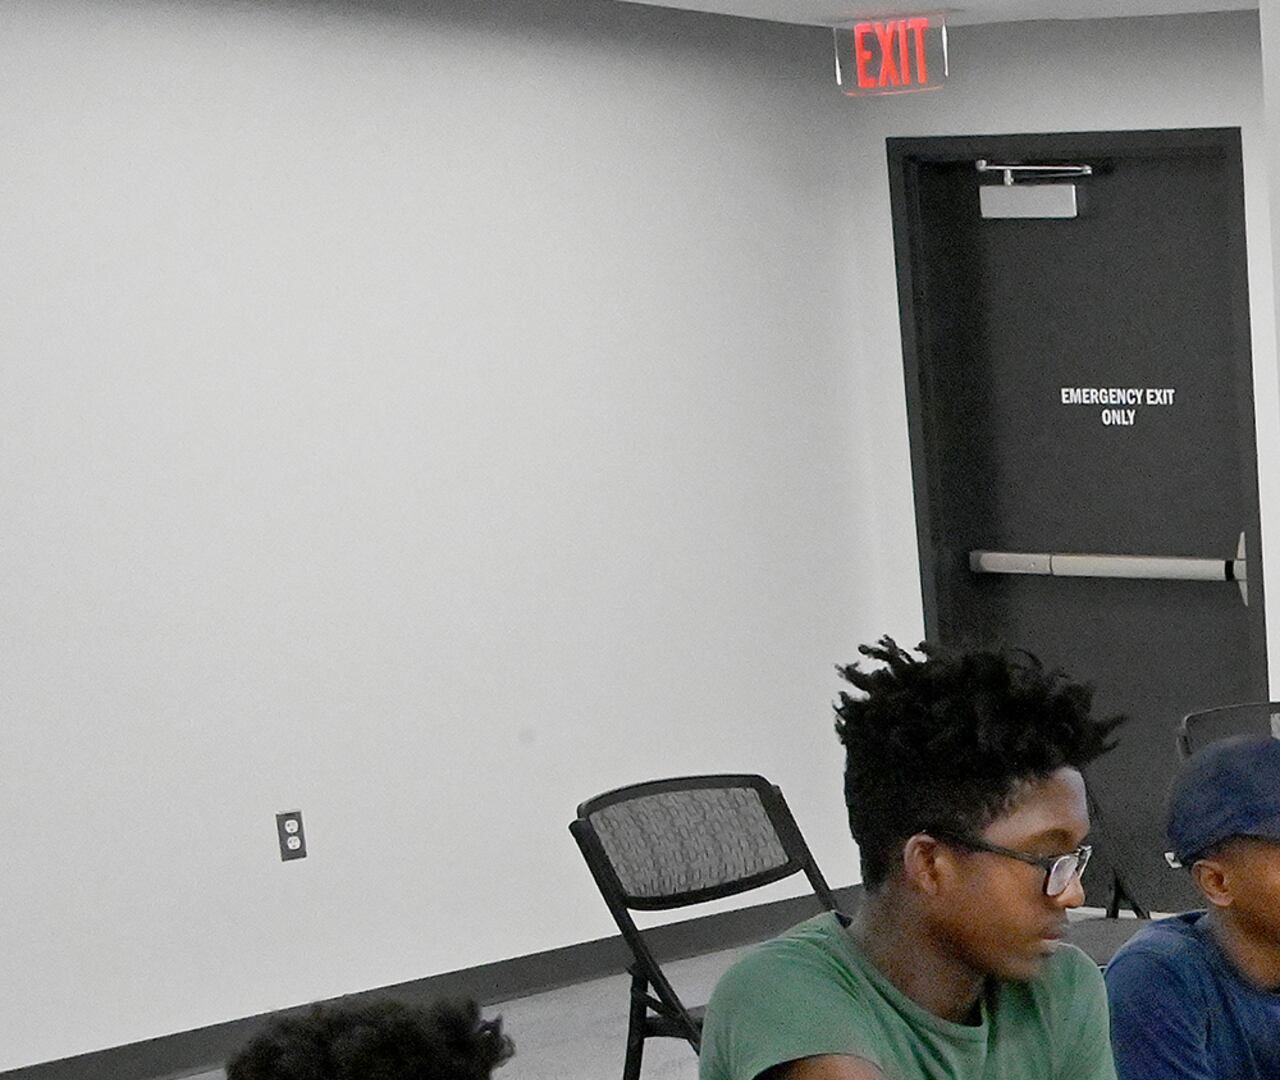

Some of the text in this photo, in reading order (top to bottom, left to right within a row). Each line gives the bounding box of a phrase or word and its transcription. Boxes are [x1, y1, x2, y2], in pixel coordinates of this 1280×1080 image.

[854, 18, 929, 88] EXIT
[1061, 388, 1175, 405] EMERGENCY EXIT
[1101, 409, 1136, 425] ONLY
